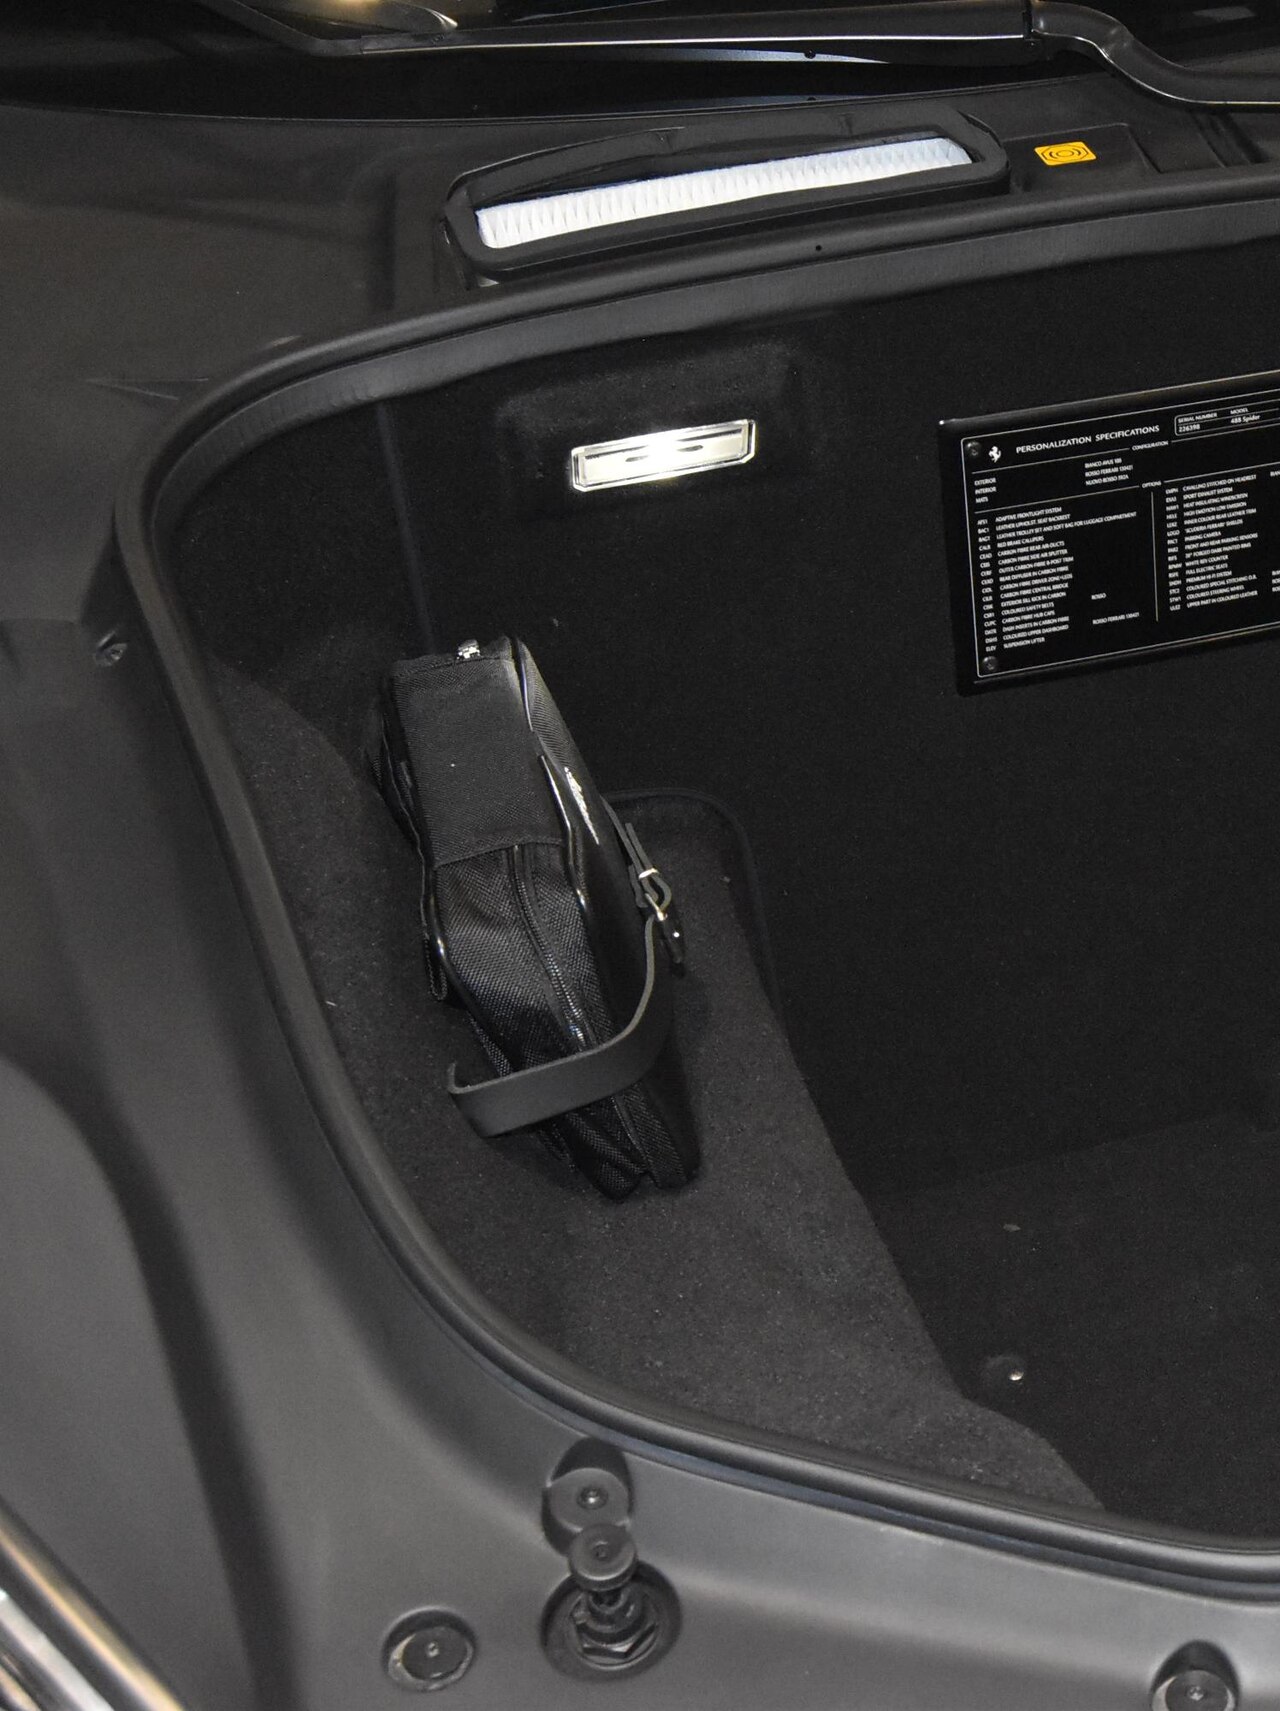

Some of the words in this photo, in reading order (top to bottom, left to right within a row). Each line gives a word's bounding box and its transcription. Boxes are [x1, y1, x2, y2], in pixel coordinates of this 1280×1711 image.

[1243, 413, 1260, 422] Spider
[1179, 424, 1200, 432] 226398
[1016, 436, 1092, 453] PERSONALIZATION
[1095, 425, 1159, 441] SPECIFICATIONS
[1132, 441, 1168, 451] CONFIGURATION
[974, 478, 996, 486] EXTERIOR
